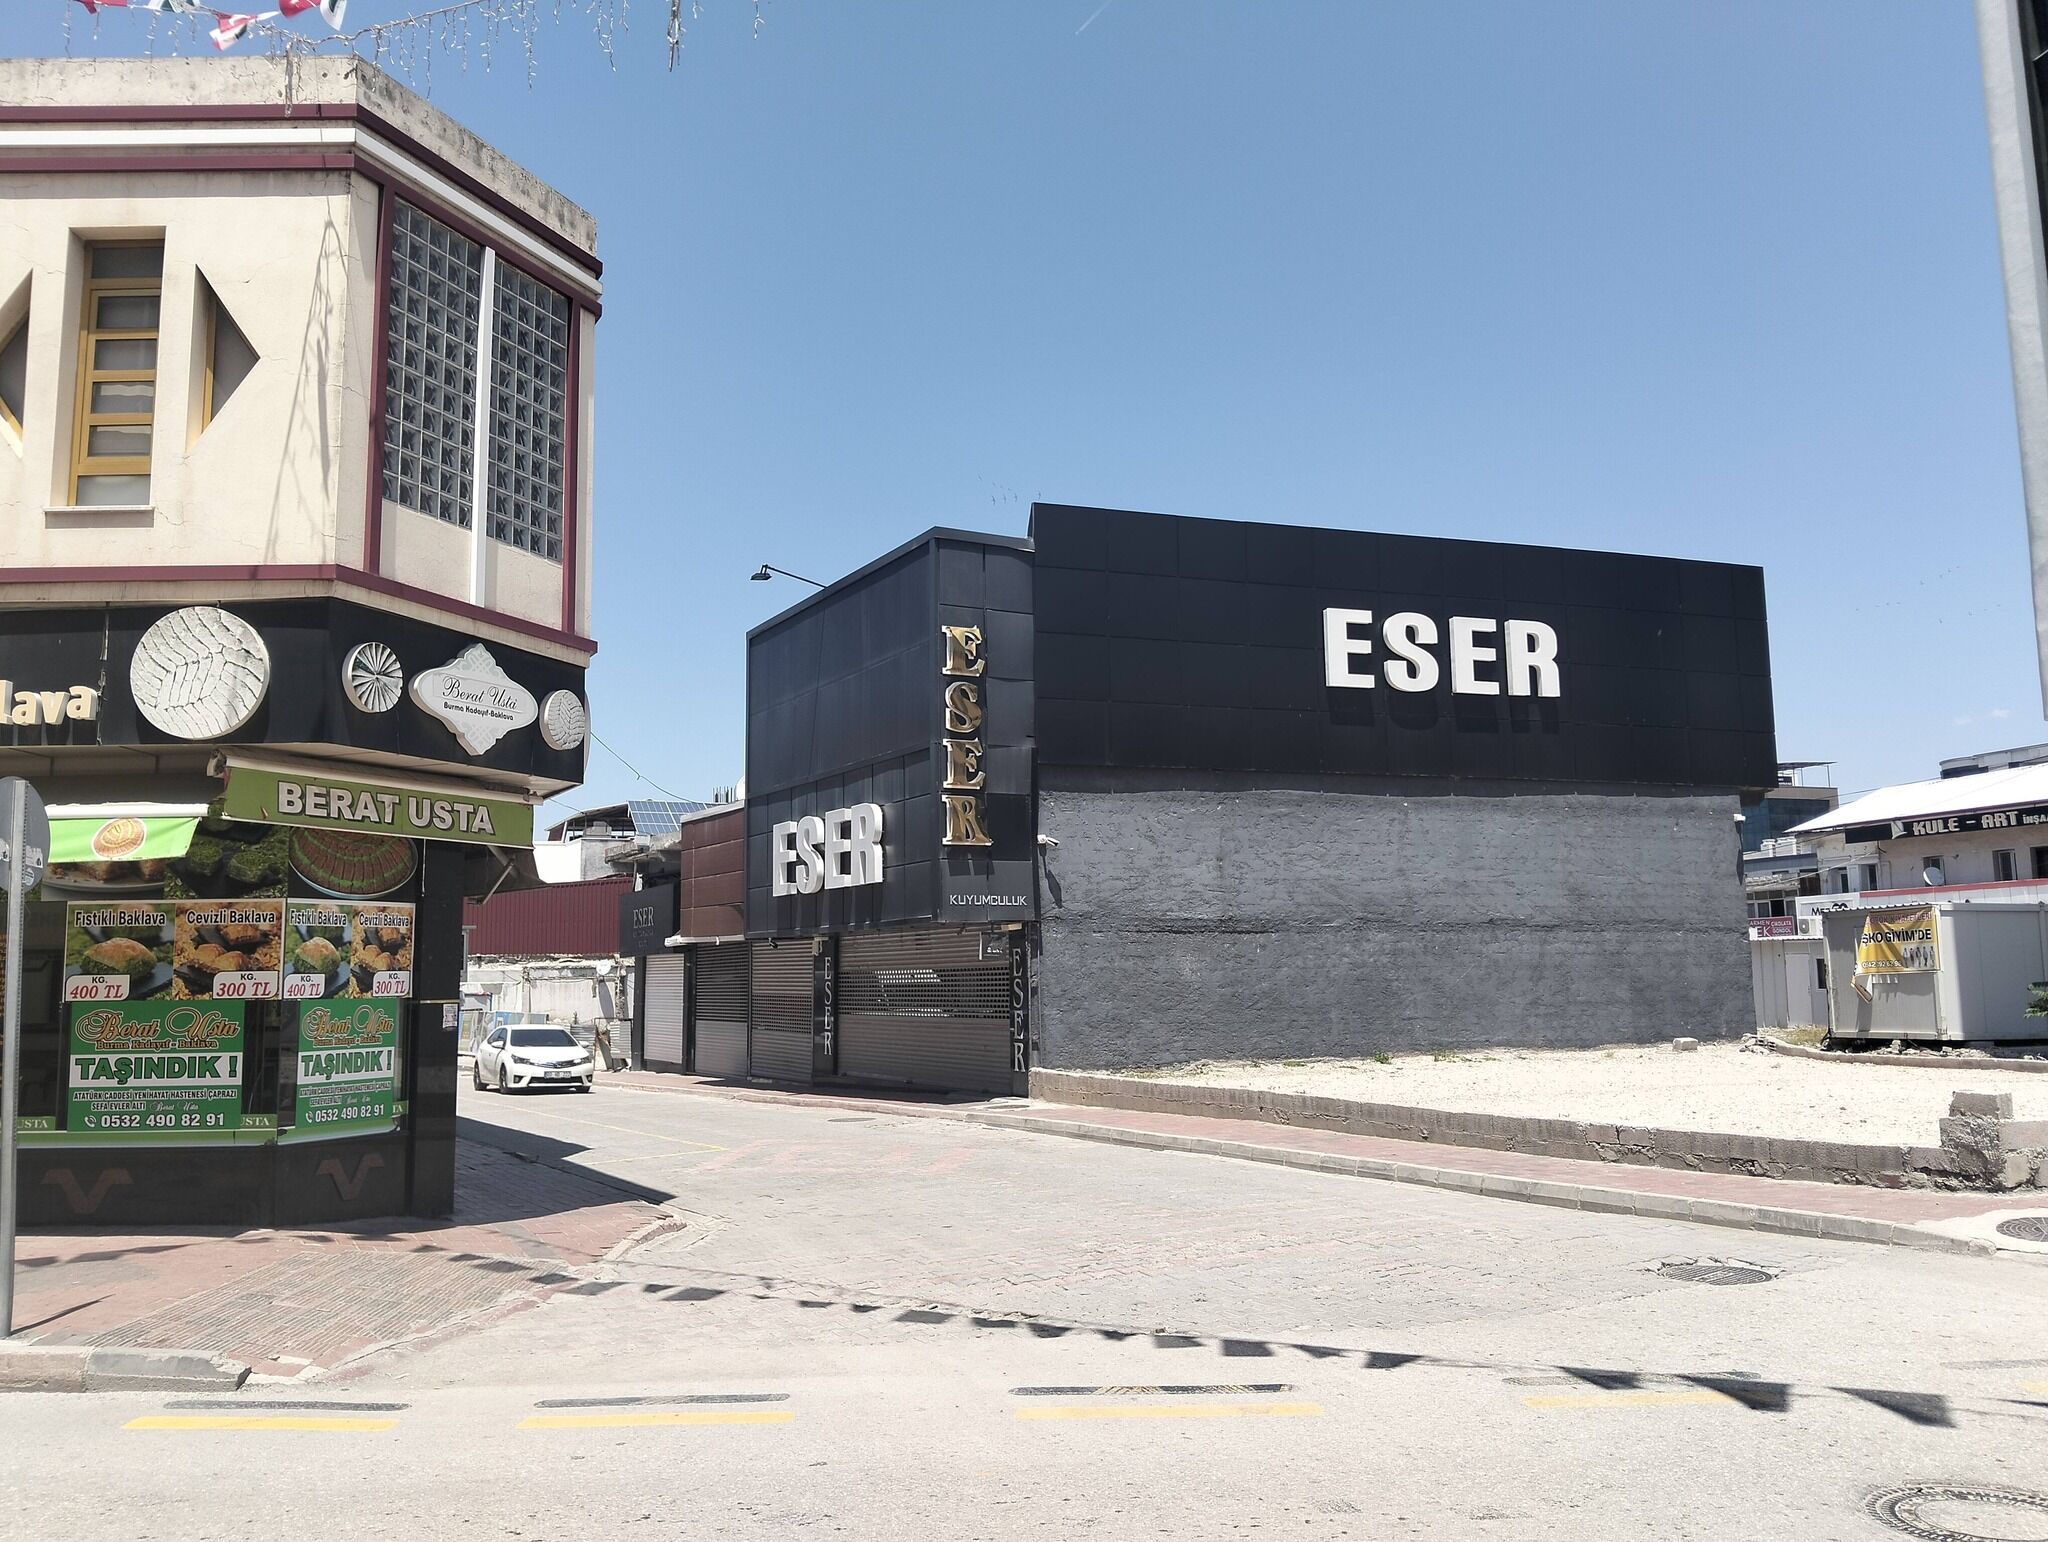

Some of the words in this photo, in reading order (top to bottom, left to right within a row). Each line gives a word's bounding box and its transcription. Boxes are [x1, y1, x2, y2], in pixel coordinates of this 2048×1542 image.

[1322, 607, 1561, 698] ESER
[442, 675, 484, 704] Berat
[487, 685, 518, 711] Usta
[0, 679, 98, 726] lava
[443, 701, 464, 712] Burma
[941, 624, 994, 847] ESER
[276, 780, 401, 825] BERAT
[407, 796, 496, 836] USTA
[1912, 817, 1960, 836] KULE
[1981, 811, 2019, 829] ART
[772, 803, 884, 897] ESER
[949, 894, 1028, 906] KUYUMCULUK
[75, 910, 115, 927] Fıstıklı
[118, 909, 166, 926] Baklava
[187, 909, 227, 925] Cevizli
[229, 909, 276, 924] Baklava
[289, 909, 316, 926] Fıstıklı
[317, 910, 347, 926] Baklava
[358, 912, 382, 927] Cevizli
[383, 914, 410, 928] Baklava
[633, 906, 654, 929] ESER
[1885, 928, 1932, 943] GİYİM'DE
[91, 976, 108, 984] KG.
[240, 973, 257, 981] KG.
[300, 975, 314, 983] KG.
[69, 984, 99, 999] 400
[103, 985, 124, 999] TL
[216, 983, 246, 997] 300
[251, 982, 271, 996] TL
[287, 984, 305, 996] 400
[308, 983, 321, 996] TL
[374, 981, 392, 994] 300
[394, 980, 406, 993] TL
[823, 957, 833, 1055] ESER
[1013, 949, 1026, 1072] ESER
[76, 1009, 160, 1044] Berat
[165, 1007, 239, 1040] Usta
[96, 1039, 129, 1050] Burma
[178, 1038, 218, 1049] Baklava
[75, 1055, 221, 1085] TAŞINDIK
[228, 1056, 238, 1078] !
[301, 1050, 384, 1081] TAŞINDIK
[73, 1089, 103, 1100] ATATÜRK
[91, 1101, 108, 1111] SEFA
[109, 1101, 131, 1111] EVLER
[131, 1101, 146, 1111] ALTI
[314, 1108, 339, 1123] 0532
[341, 1106, 358, 1120] 490
[360, 1105, 372, 1118] 82
[374, 1104, 384, 1117] 91
[101, 1115, 140, 1128] 0532
[145, 1114, 176, 1127] 490
[181, 1114, 200, 1127] 82
[206, 1113, 224, 1126] 91
